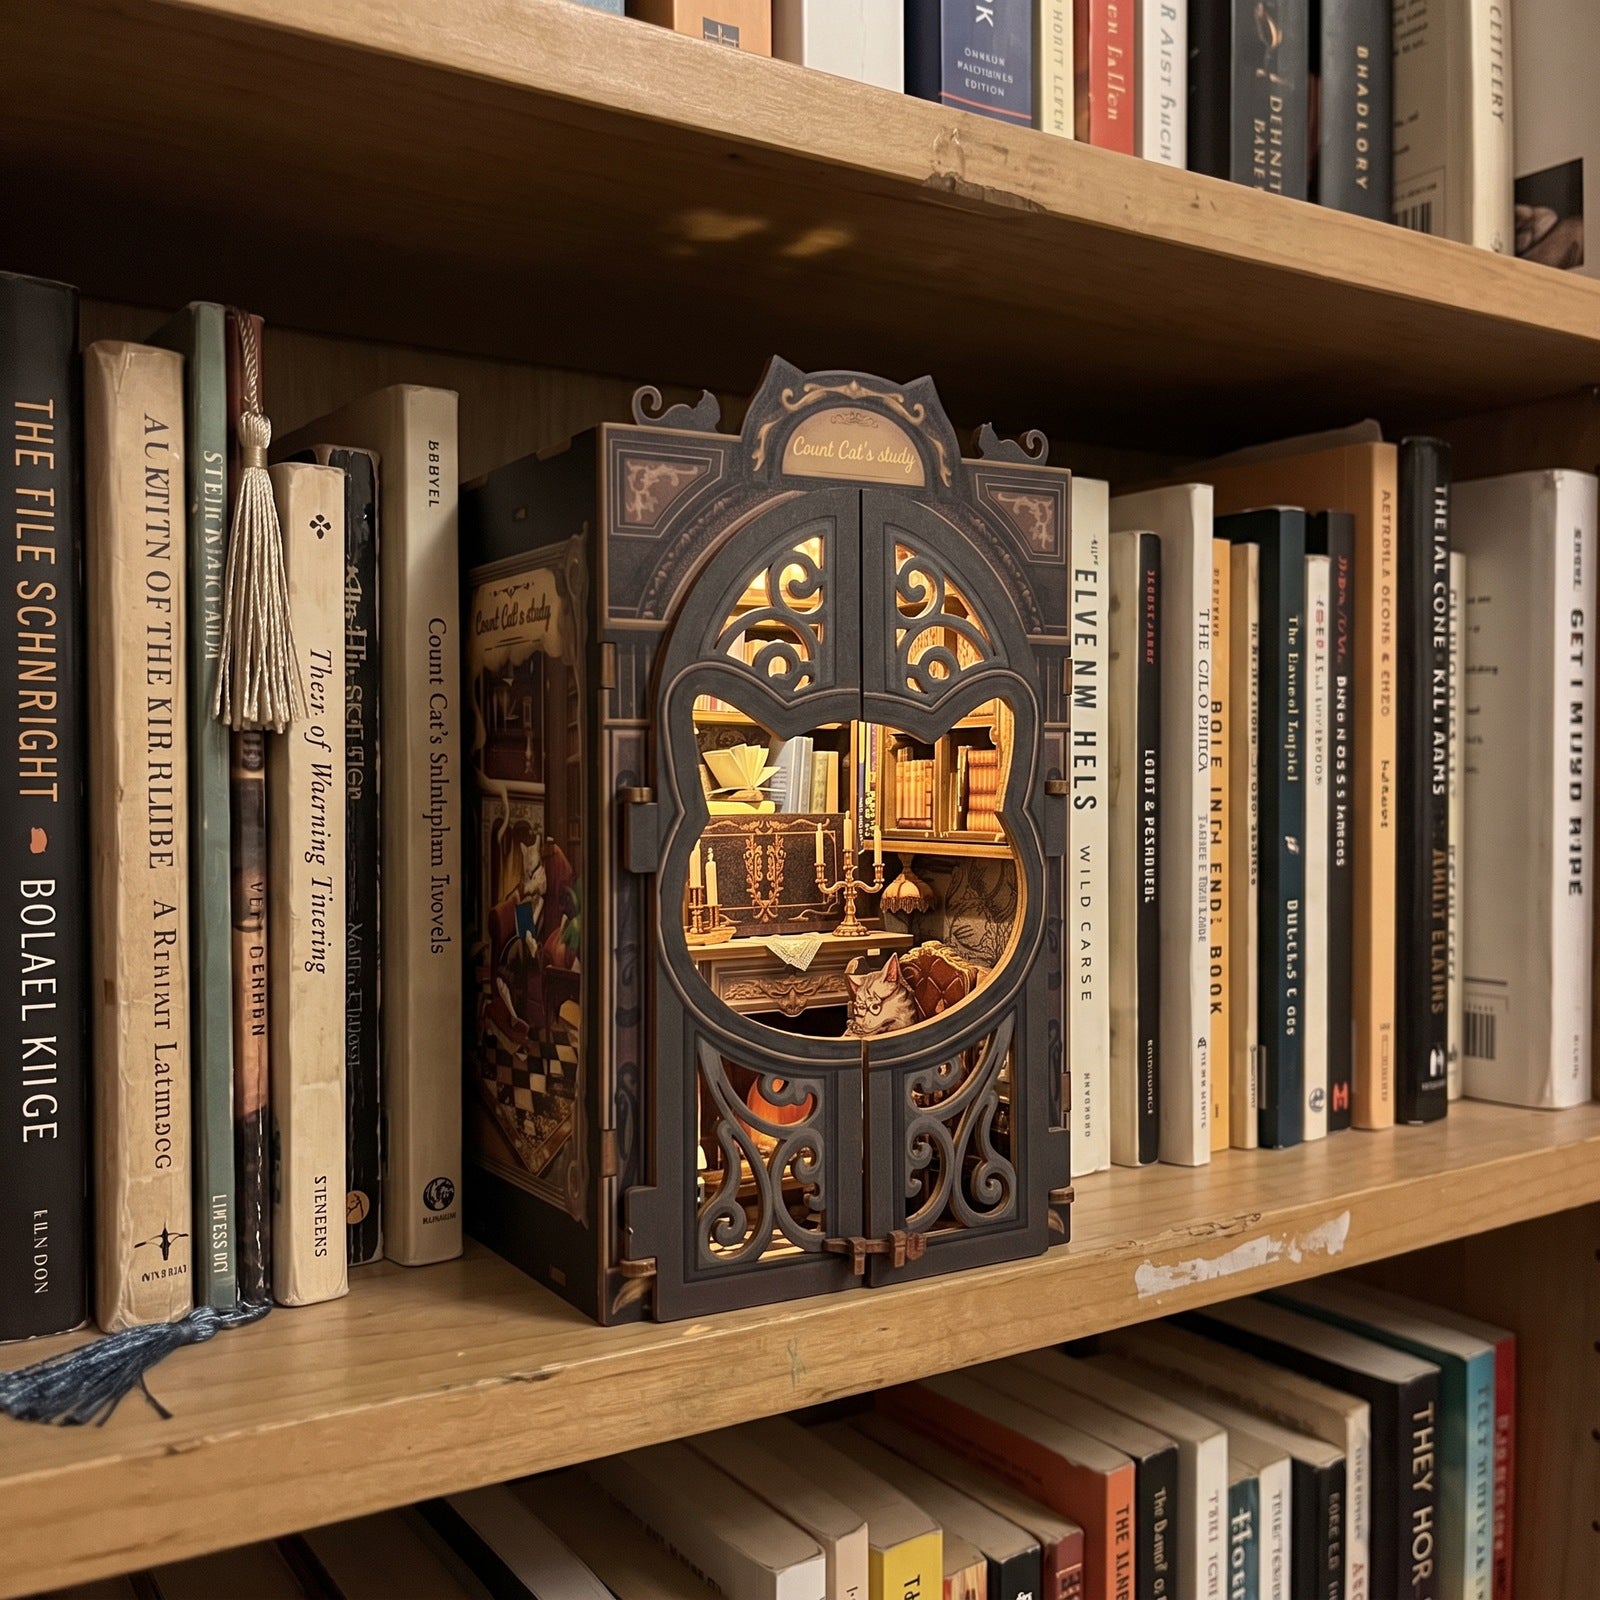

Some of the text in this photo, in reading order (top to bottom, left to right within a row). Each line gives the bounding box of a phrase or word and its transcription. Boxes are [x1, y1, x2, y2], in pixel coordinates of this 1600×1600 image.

[964, 78, 1005, 97] EDITION
[1356, 45, 1370, 190] BHADLORY
[793, 435, 917, 475] Count Cat's study
[15, 398, 58, 803] THE FILE SCHNRIGHT
[145, 570, 173, 613] OF
[475, 606, 500, 636] Count
[526, 592, 552, 633] study
[1433, 581, 1448, 649] CONE
[146, 621, 173, 686] THE
[428, 617, 448, 685] Count
[1198, 608, 1211, 650] THE
[1288, 614, 1300, 646] The
[1570, 608, 1585, 668] GET
[304, 725, 333, 754] of
[428, 693, 449, 745] Cat's
[1073, 730, 1098, 810] HELS
[1144, 801, 1156, 812] &
[154, 900, 177, 921] A
[1080, 845, 1092, 1001] WILD CARSE
[20, 879, 56, 1022] BOLAEL
[1210, 945, 1223, 1015] BOOK
[1411, 1401, 1436, 1587] THEY HOR
[1115, 1503, 1131, 1546] THE
